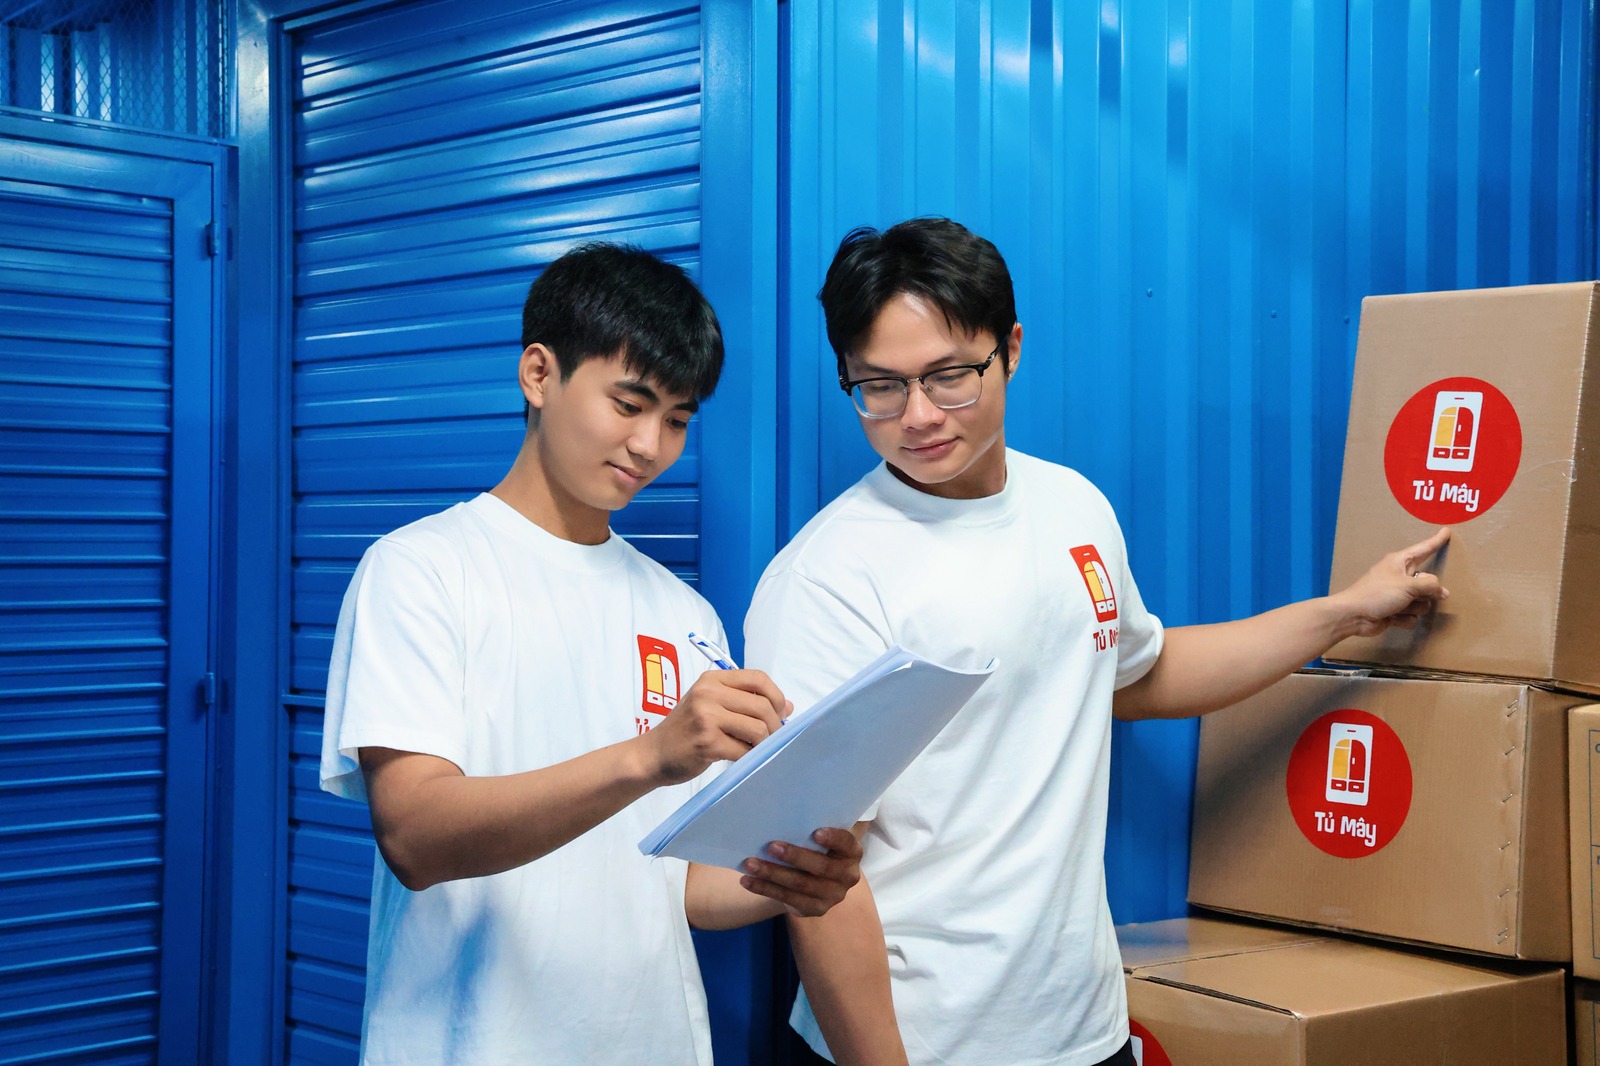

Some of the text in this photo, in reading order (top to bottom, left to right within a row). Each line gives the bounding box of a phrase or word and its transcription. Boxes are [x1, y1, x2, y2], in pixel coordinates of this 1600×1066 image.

[1412, 480, 1480, 512] Tủ Mây
[1093, 629, 1106, 652] Tủ
[1314, 811, 1377, 847] Tủ Mây
